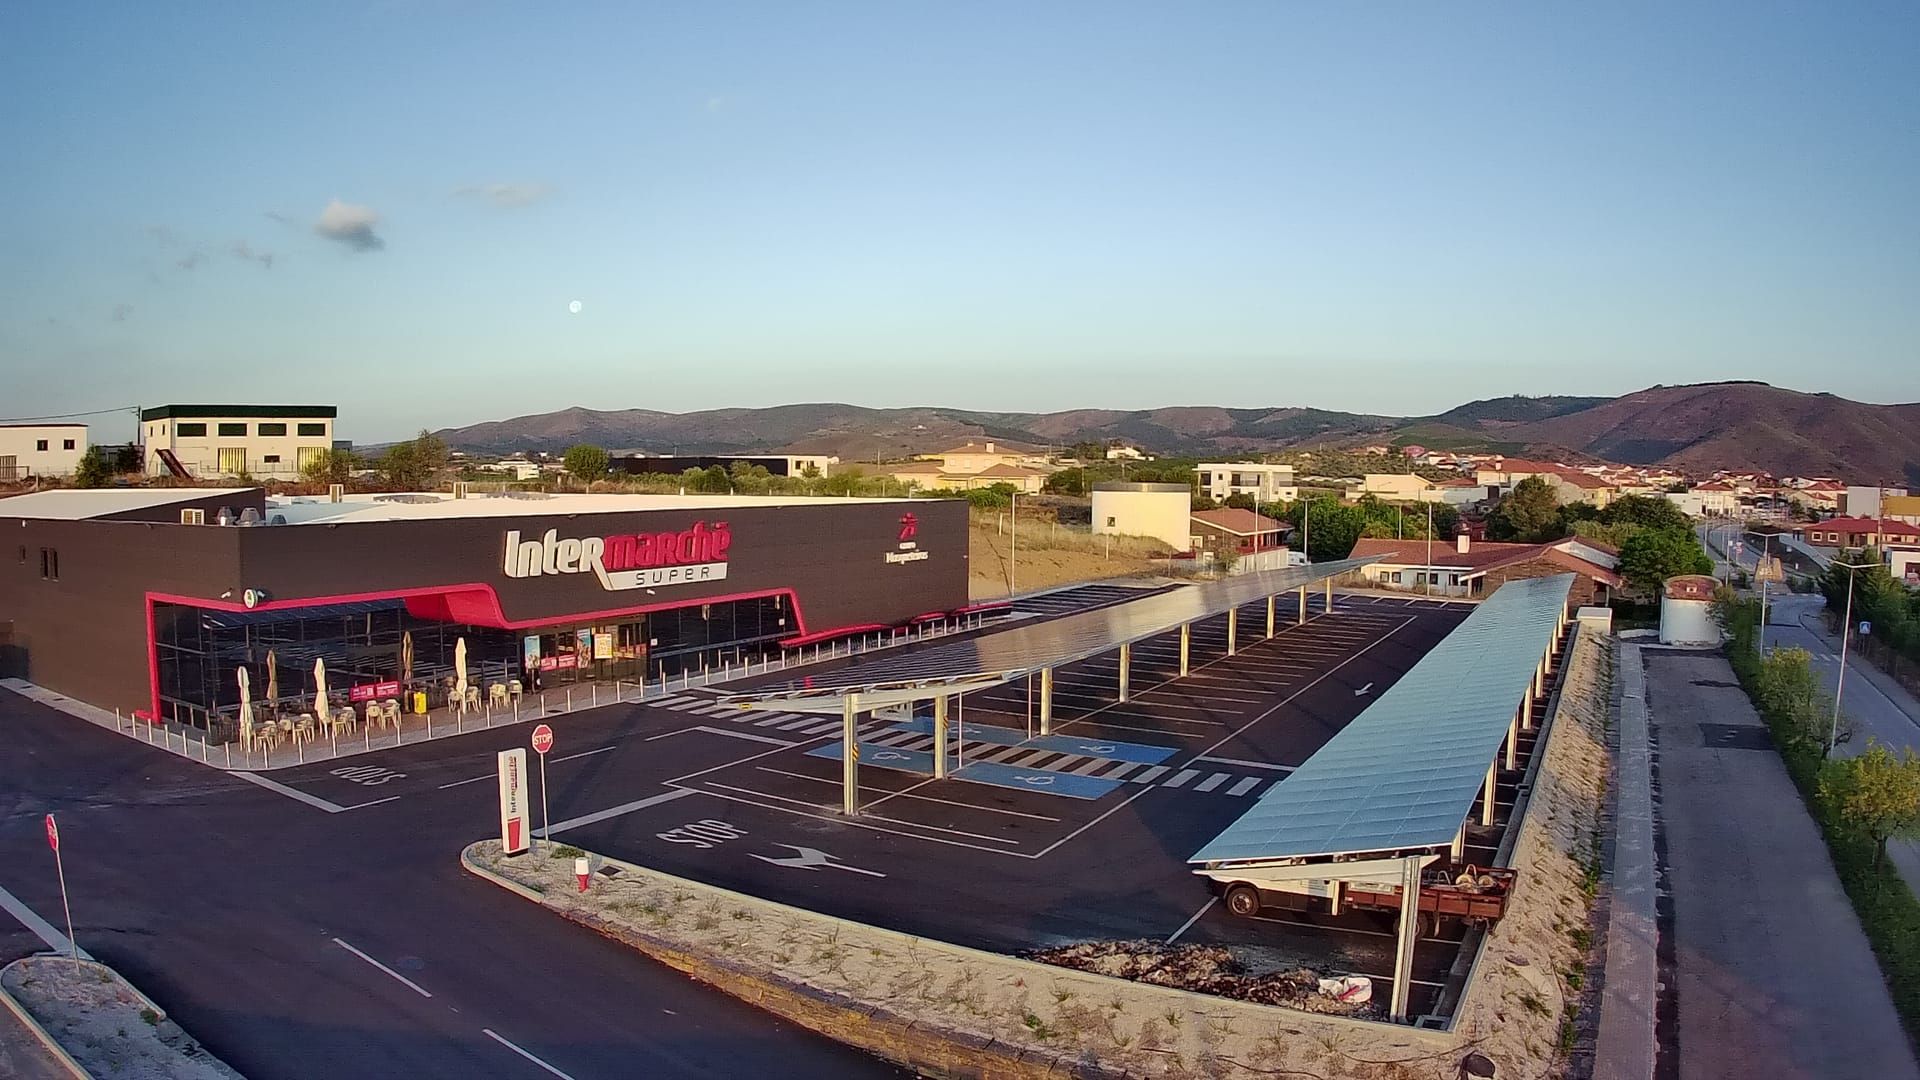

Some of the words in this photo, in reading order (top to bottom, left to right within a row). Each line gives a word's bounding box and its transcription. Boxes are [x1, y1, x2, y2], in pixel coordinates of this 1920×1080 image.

[504, 521, 731, 590] Intermarché
[534, 733, 552, 746] STOP
[329, 765, 408, 786] STOP
[656, 819, 749, 848] STOP
